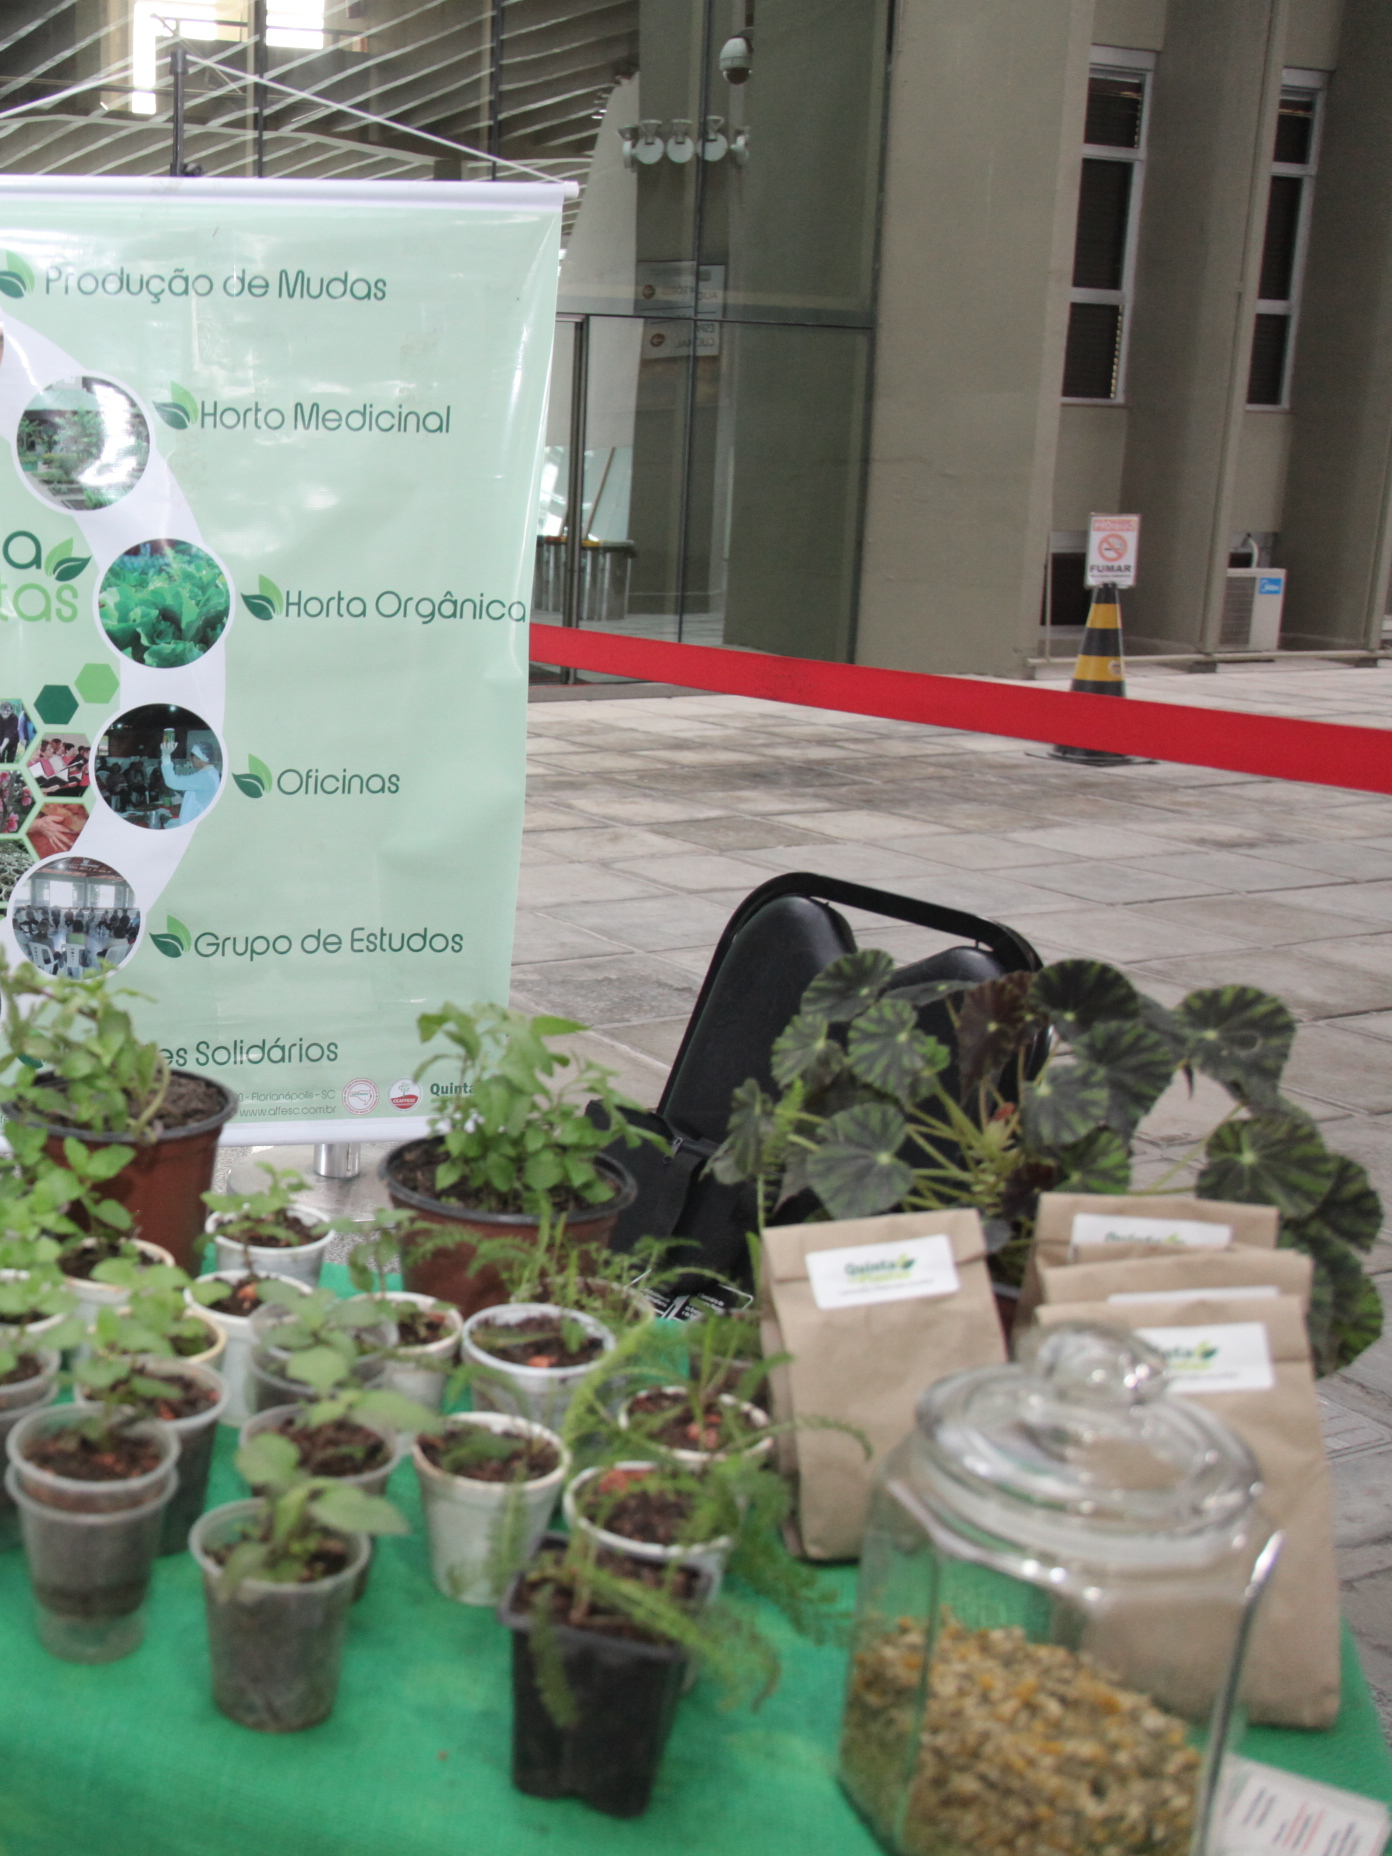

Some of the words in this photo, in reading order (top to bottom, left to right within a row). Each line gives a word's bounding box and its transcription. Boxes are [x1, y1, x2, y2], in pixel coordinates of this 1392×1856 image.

[46, 266, 214, 304] Produção
[223, 267, 270, 298] de
[278, 269, 387, 301] Mudas
[200, 400, 286, 429] Horto
[294, 402, 451, 434] Medicinal
[1089, 564, 1131, 573] FUMAR
[285, 590, 367, 618] Horta
[375, 590, 526, 624] Orgânica
[277, 768, 401, 796] Oficinas
[194, 932, 293, 962] Grupo
[300, 928, 343, 954] de
[350, 927, 464, 954] Estudos
[195, 1037, 339, 1067] Solidários
[251, 1090, 314, 1103] Florianópolis
[321, 1089, 336, 1100] SC
